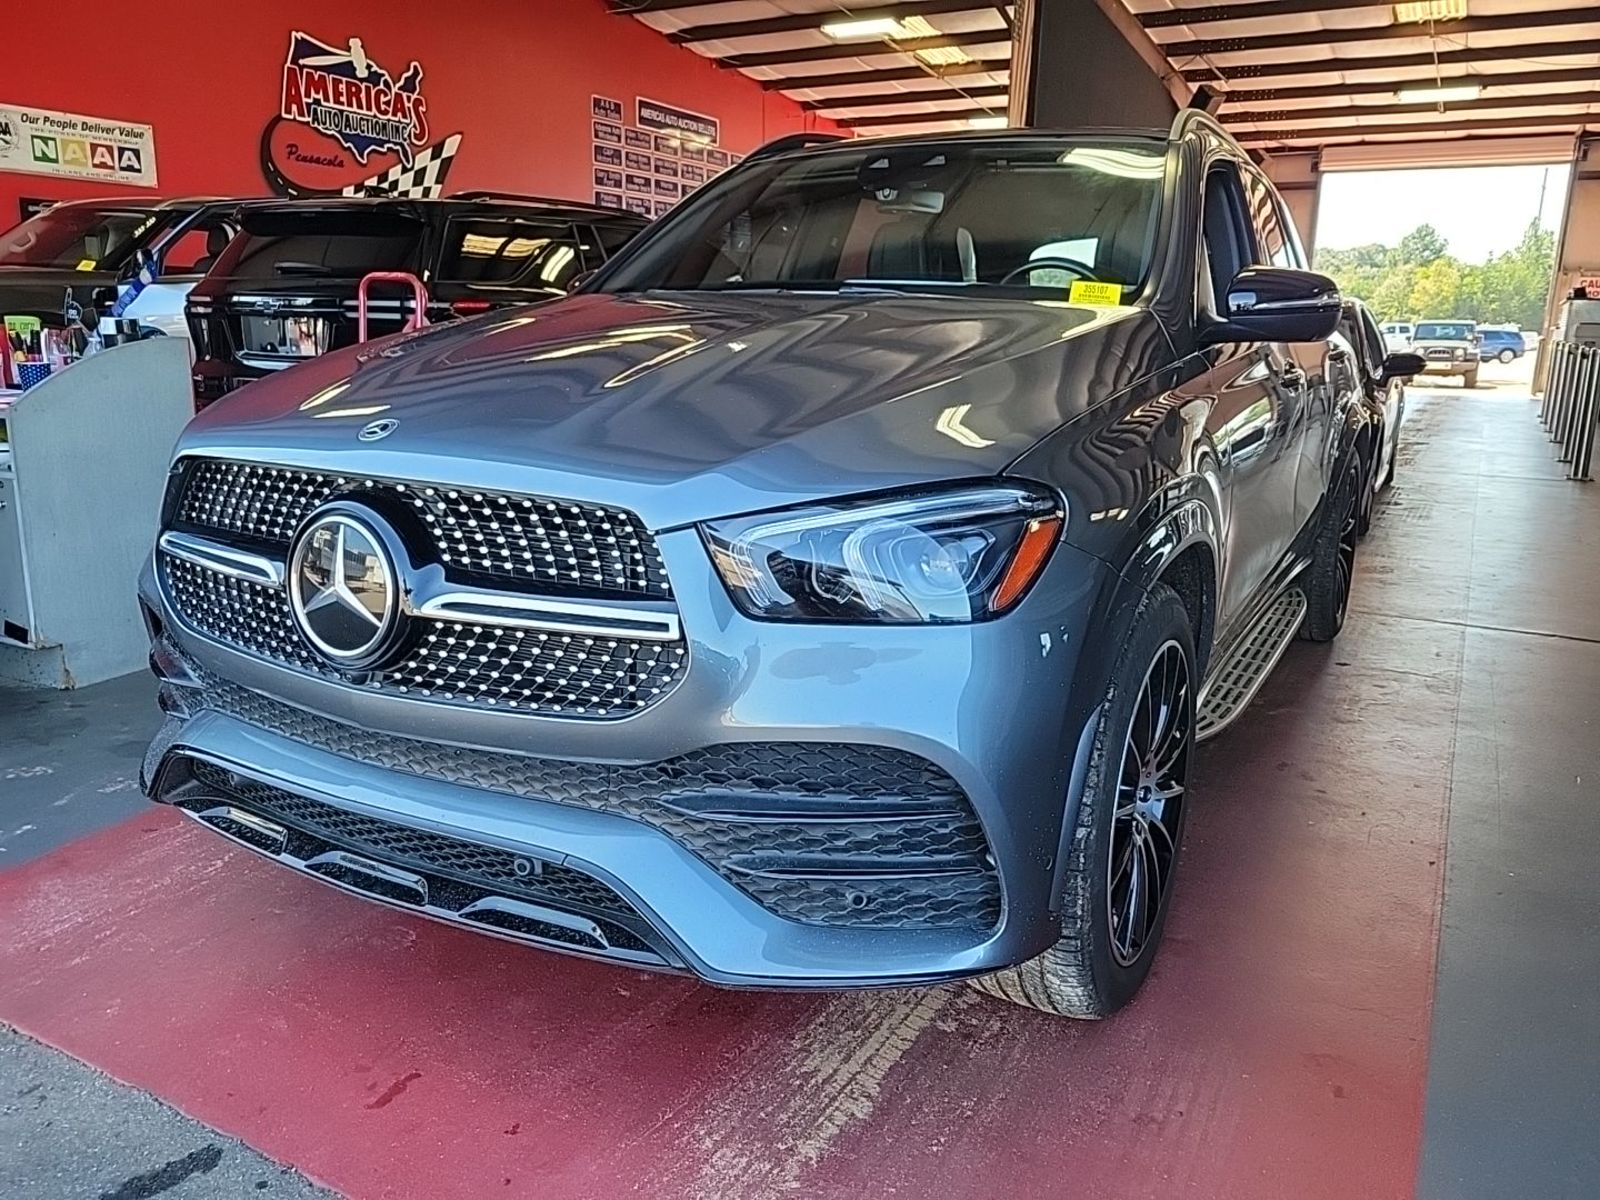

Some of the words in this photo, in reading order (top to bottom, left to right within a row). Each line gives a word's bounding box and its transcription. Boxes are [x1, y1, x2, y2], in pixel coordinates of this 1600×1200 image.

[282, 64, 428, 145] AMERICA'S
[20, 112, 41, 125] Our
[43, 115, 78, 131] People
[81, 121, 116, 136] Deliver
[118, 126, 145, 140] Value
[310, 105, 341, 131] AUTO
[343, 112, 390, 140] AUCTION
[666, 114, 678, 126] AUTO
[678, 118, 698, 131] AUCTION
[698, 124, 716, 137] SELLERS
[286, 143, 345, 168] Pensacola
[1083, 284, 1109, 294] 355107
